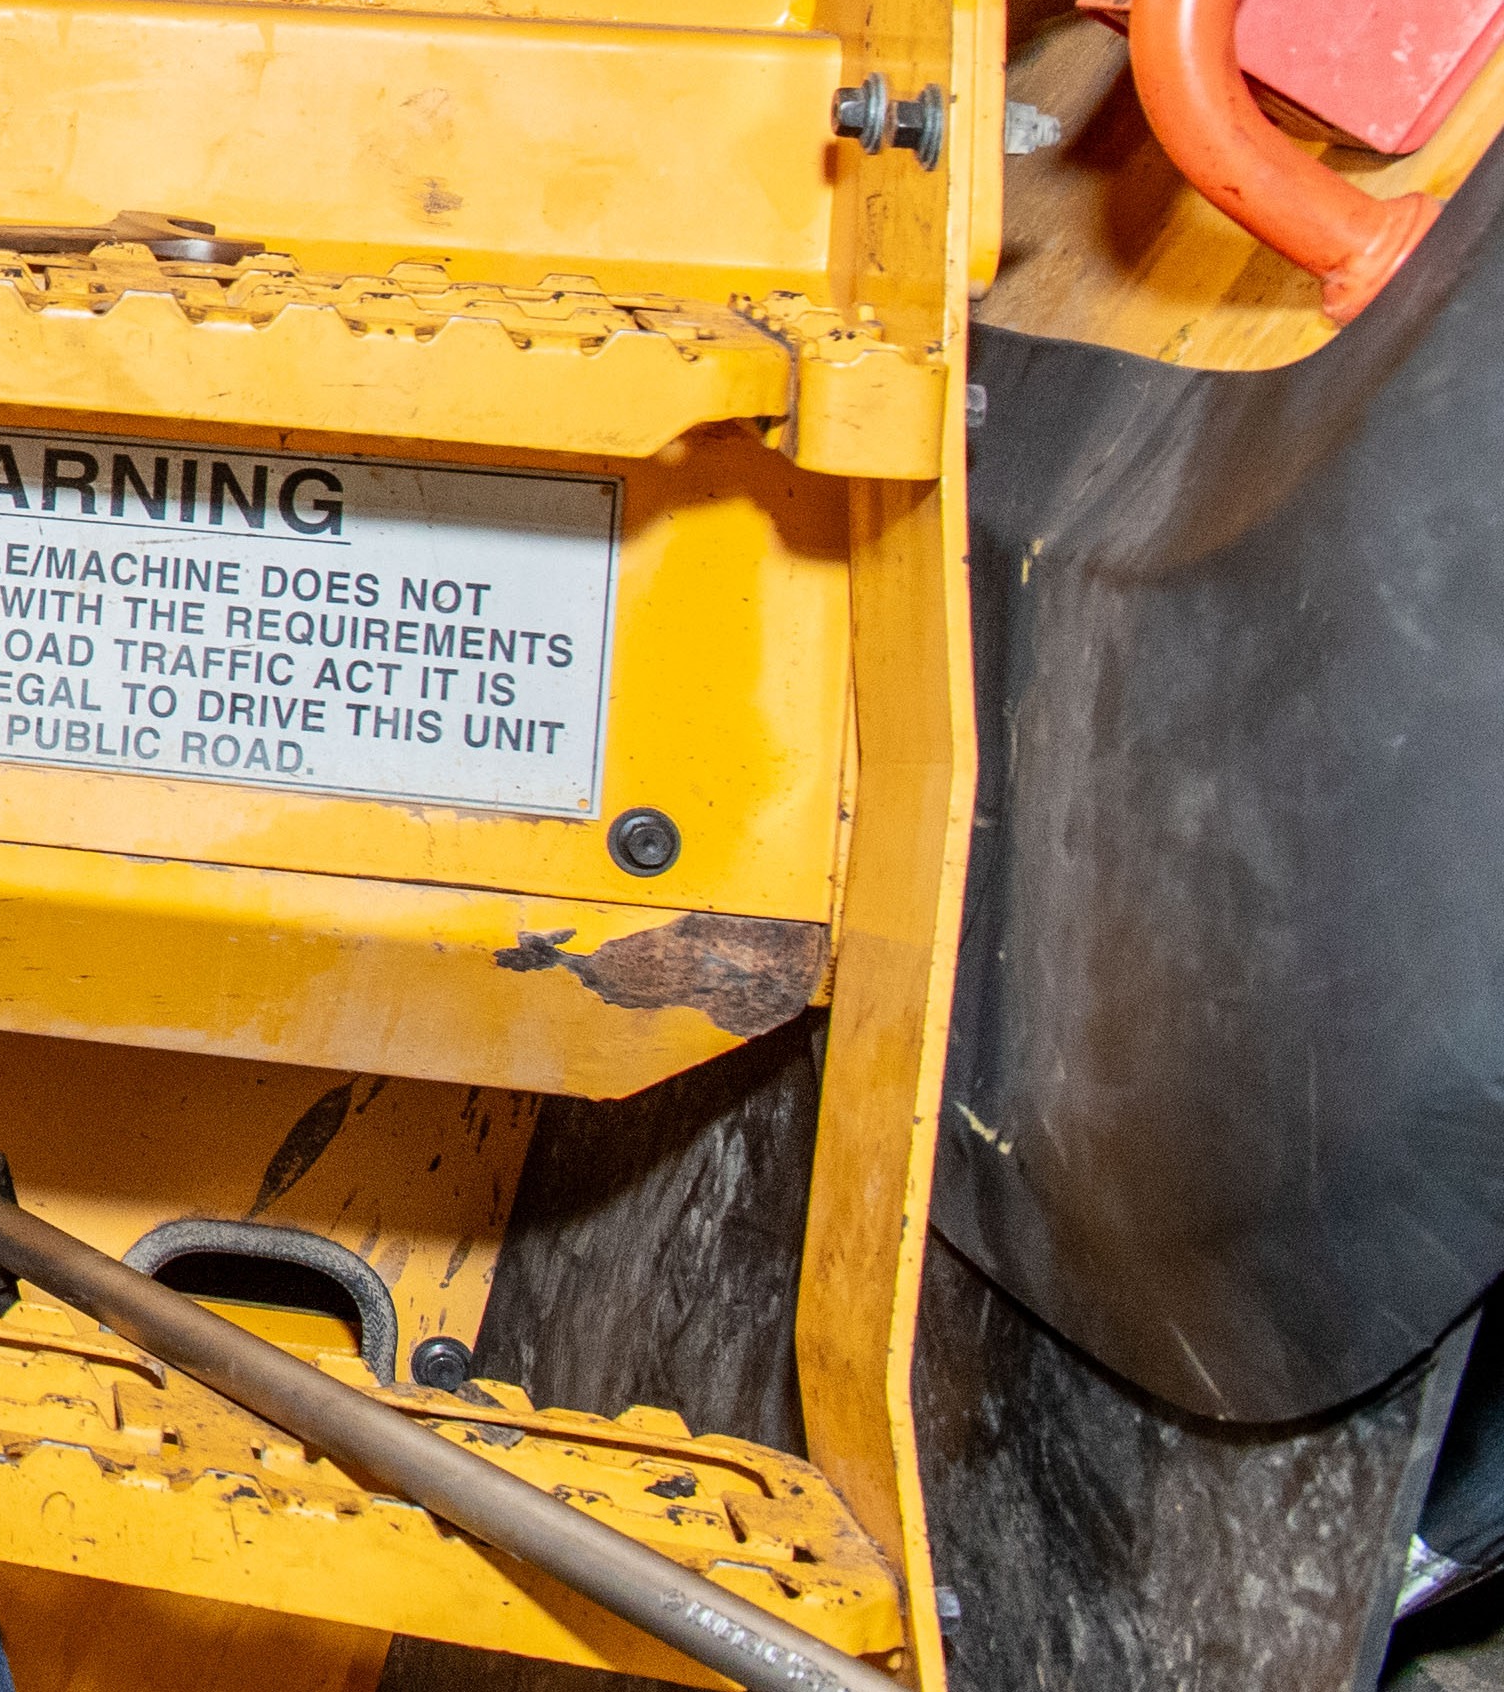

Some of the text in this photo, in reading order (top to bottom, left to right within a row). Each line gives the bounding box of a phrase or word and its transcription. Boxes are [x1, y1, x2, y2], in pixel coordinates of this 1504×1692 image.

[260, 564, 380, 608] DOES
[399, 576, 492, 617] NOT
[122, 595, 206, 636] THE
[225, 604, 574, 669] REQUIREMENTS
[112, 638, 296, 687] TRAFFIC
[312, 657, 403, 697] ACT
[420, 665, 460, 702] IT
[476, 670, 516, 708] IS
[6, 713, 161, 760] PUBLIC
[180, 730, 314, 778] ROAD.
[121, 681, 178, 719] TO
[197, 688, 327, 734] DRIVE
[345, 702, 443, 744] THIS
[463, 713, 566, 755] UNIT
